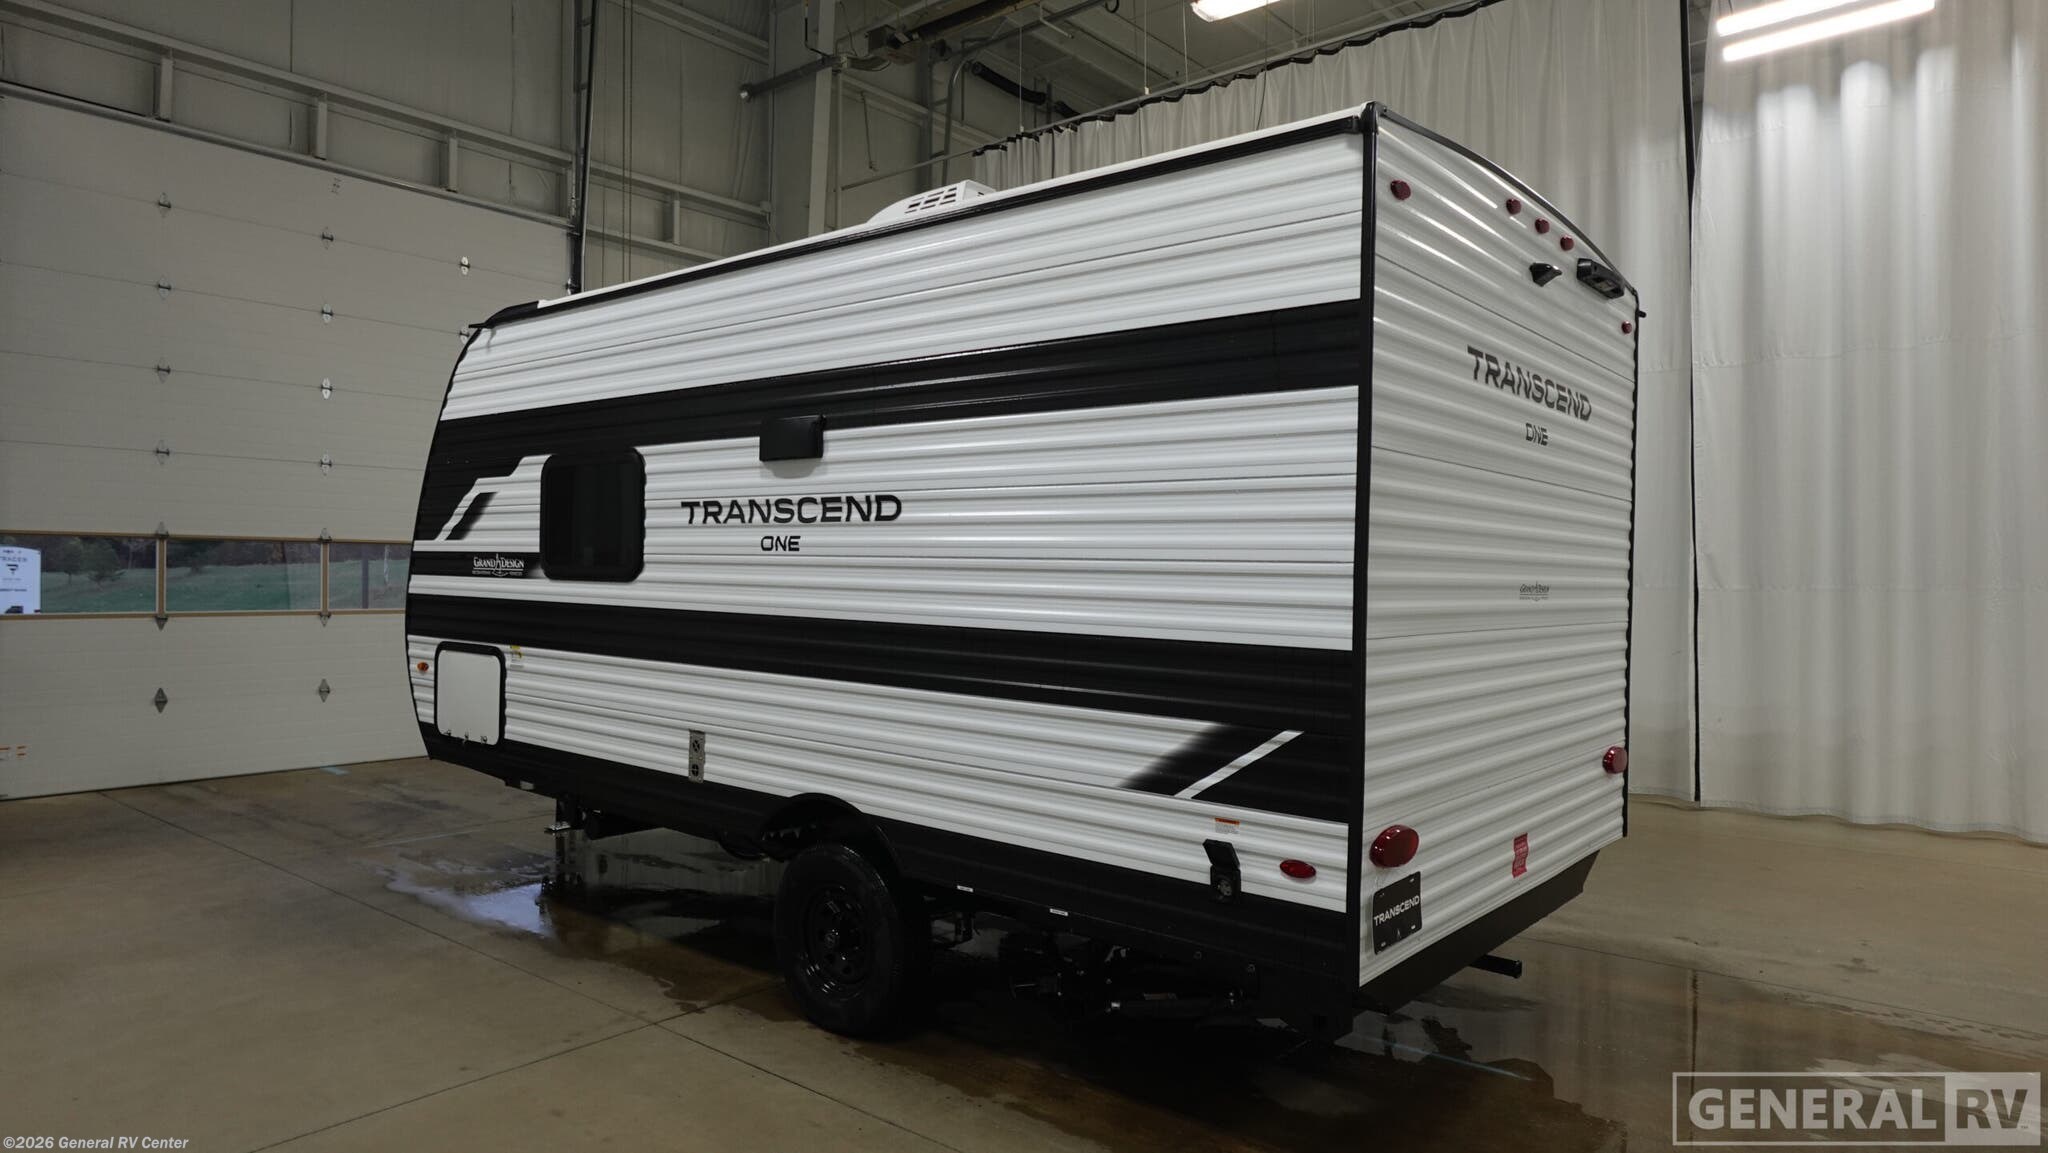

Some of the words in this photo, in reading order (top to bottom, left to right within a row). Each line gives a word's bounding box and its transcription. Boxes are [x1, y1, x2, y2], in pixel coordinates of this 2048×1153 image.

[1467, 344, 1592, 421] TRANSCEND
[1525, 422, 1549, 446] ONE
[681, 494, 902, 525] TRANSCEND
[760, 535, 801, 552] ONE
[473, 556, 496, 568] GRAND
[500, 556, 525, 569] DESIGN
[1373, 895, 1420, 926] TRANSCEND
